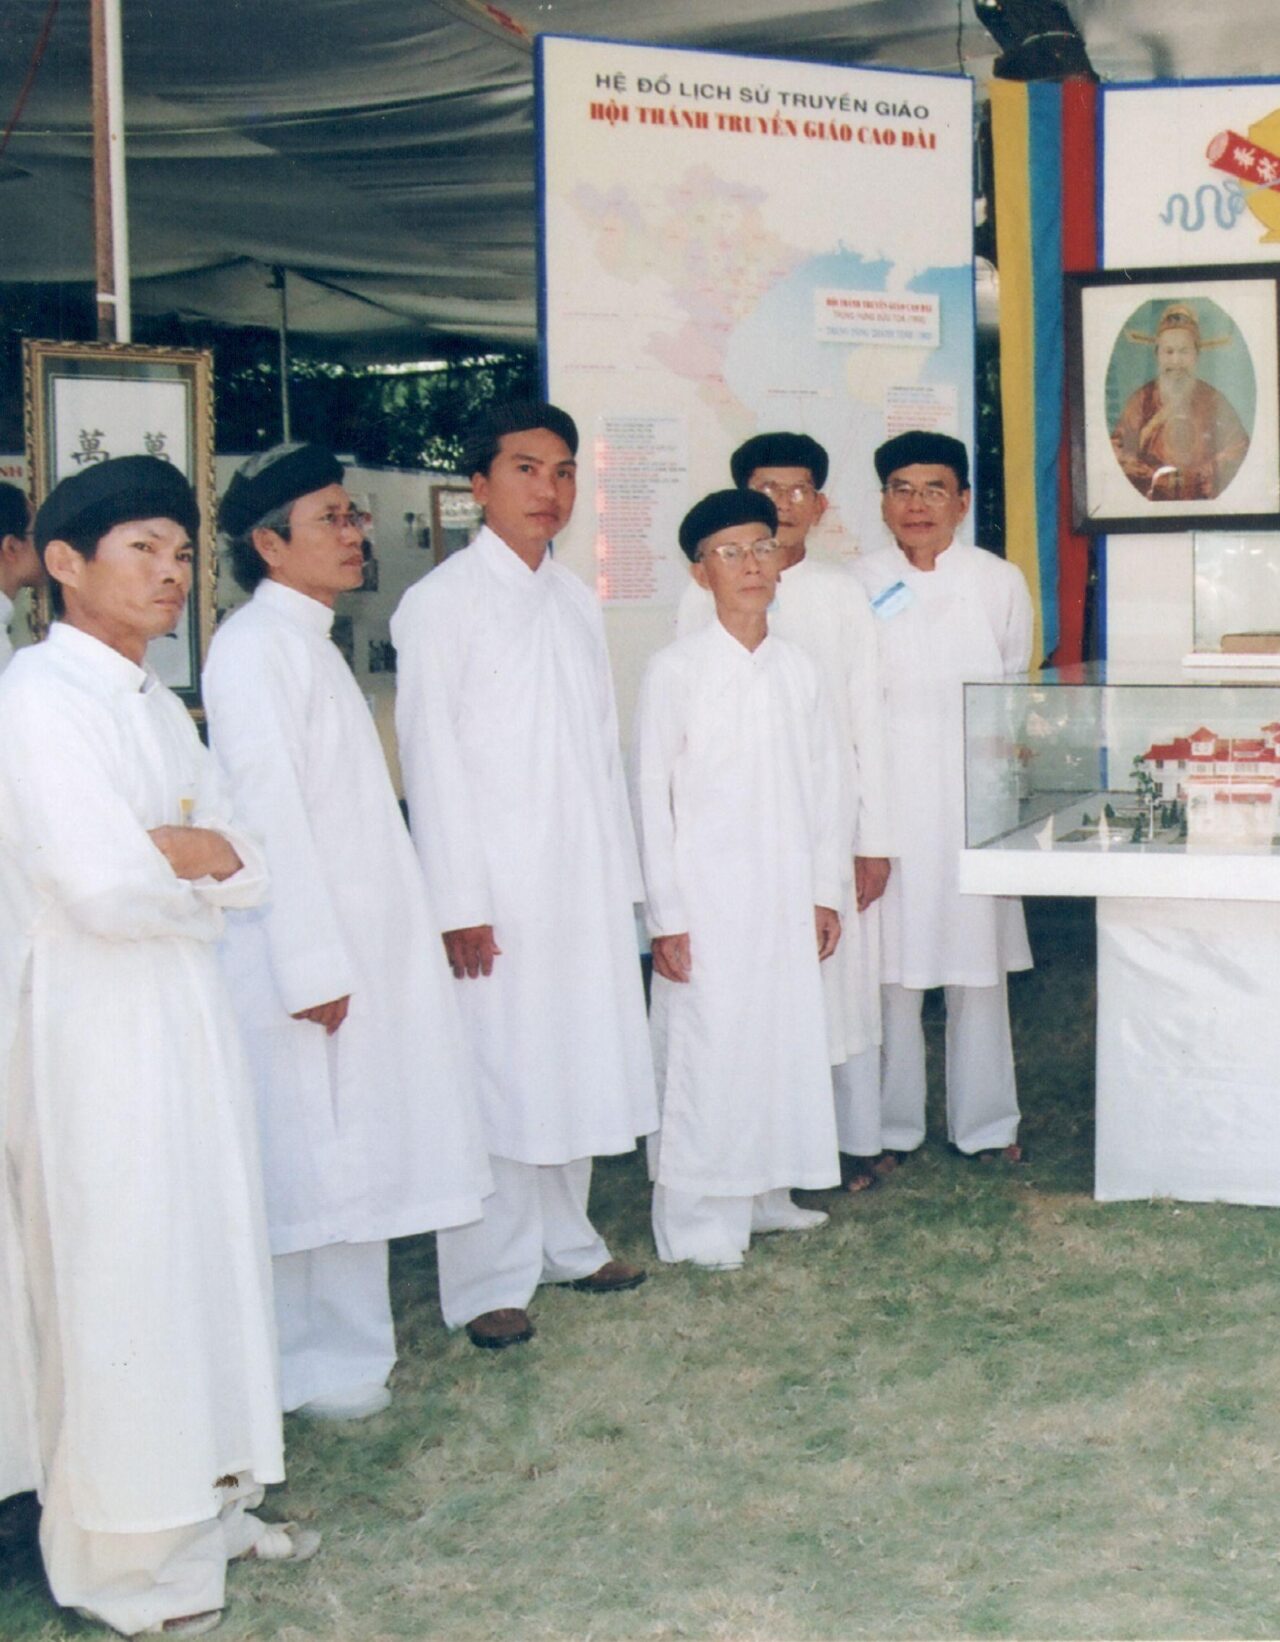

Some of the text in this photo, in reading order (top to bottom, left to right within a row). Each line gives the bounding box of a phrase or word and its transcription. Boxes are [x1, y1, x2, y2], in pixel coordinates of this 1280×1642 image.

[596, 71, 627, 94] HỆ
[680, 82, 731, 100] LỊCH
[739, 84, 769, 104] SỬ
[875, 98, 930, 119] GIÁO
[590, 99, 629, 127] HỘI
[636, 105, 708, 129] THÁNH
[717, 109, 797, 137] TRUYỀN
[804, 118, 852, 142] GIÁO
[857, 125, 896, 146] CAO
